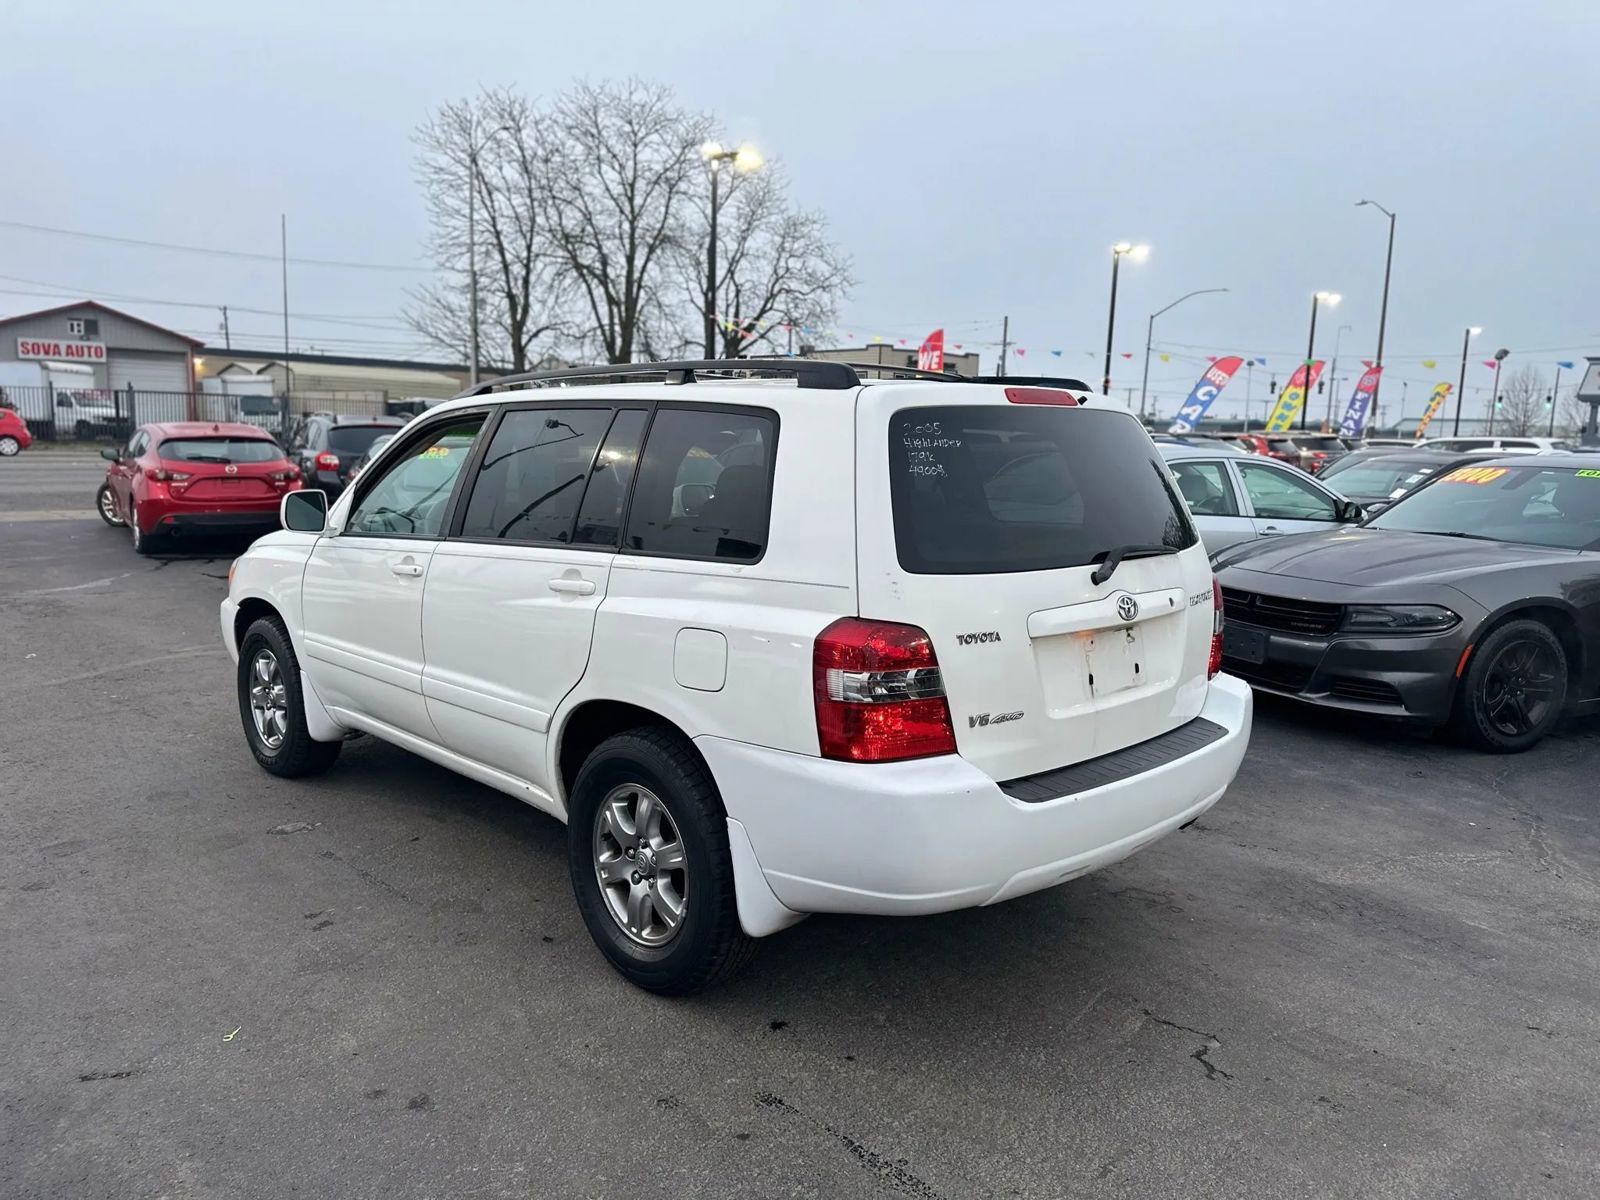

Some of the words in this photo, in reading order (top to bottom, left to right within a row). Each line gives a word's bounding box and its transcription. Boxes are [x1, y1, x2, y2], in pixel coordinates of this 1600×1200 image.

[20, 341, 62, 357] SOVA
[65, 344, 104, 359] AUTO
[918, 350, 940, 370] WE
[1206, 367, 1231, 386] USED
[903, 422, 942, 436] 2005
[956, 631, 1002, 645] TOYOTA
[968, 713, 990, 728] V6
